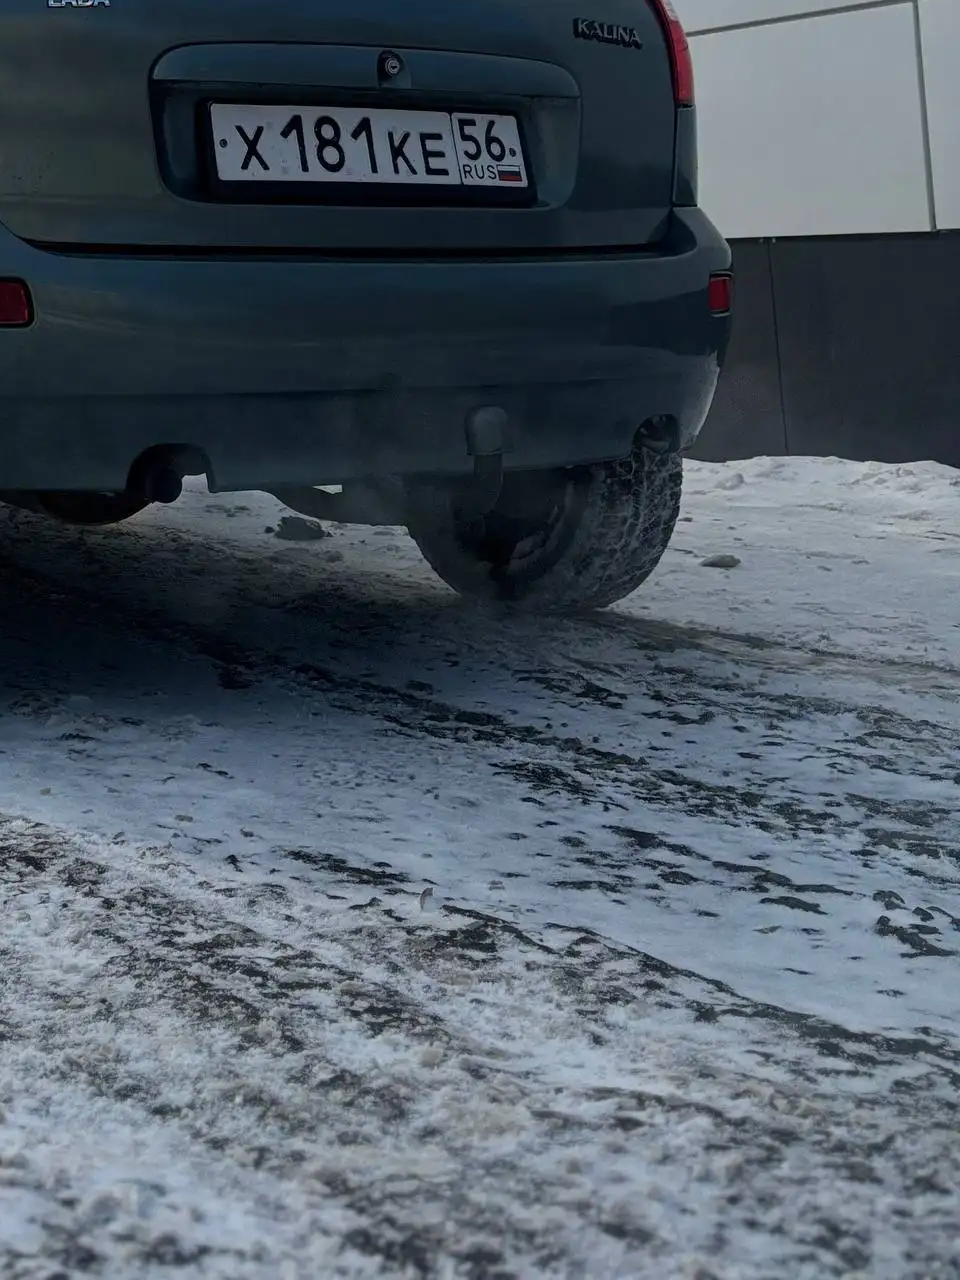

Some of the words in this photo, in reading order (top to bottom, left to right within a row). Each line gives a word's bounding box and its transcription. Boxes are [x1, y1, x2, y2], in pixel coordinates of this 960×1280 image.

[573, 18, 643, 49] KALINA
[457, 118, 506, 162] 56
[462, 164, 497, 180] RUS
